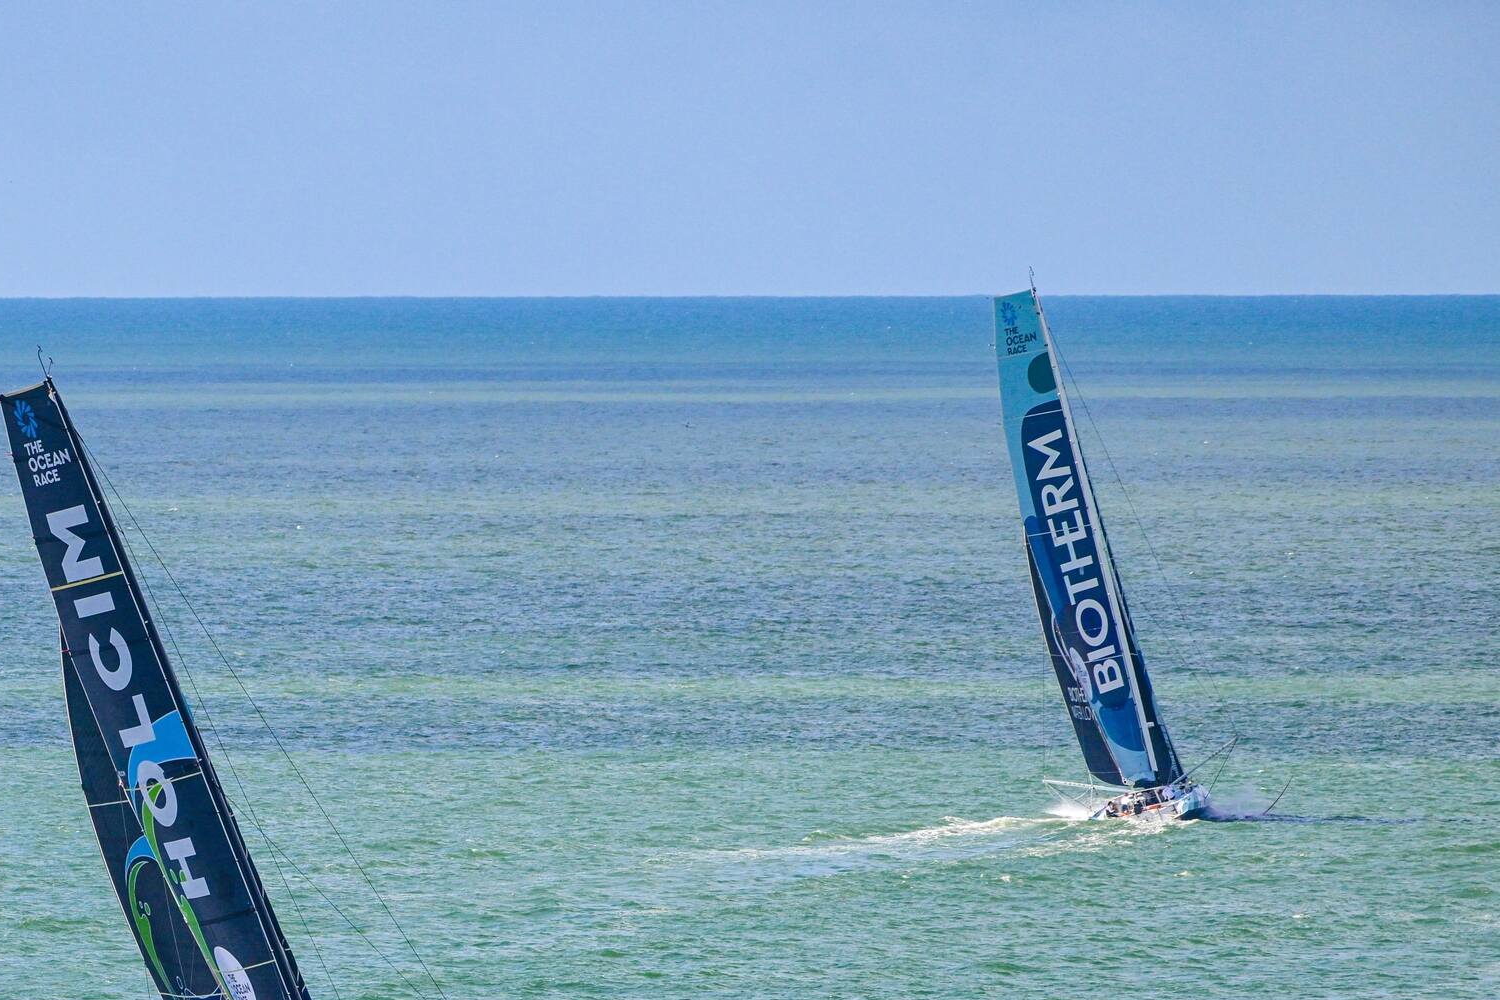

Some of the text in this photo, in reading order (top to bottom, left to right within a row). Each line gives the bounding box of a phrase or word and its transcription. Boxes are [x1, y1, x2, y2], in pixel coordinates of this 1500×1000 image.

[1004, 326, 1019, 336] THE
[1006, 332, 1037, 346] OCEAN
[1007, 344, 1028, 355] RACE
[24, 440, 44, 456] THE
[28, 448, 71, 473] OCEAN
[33, 468, 61, 487] RACE
[1027, 429, 1125, 695] BIOTHERM
[45, 504, 211, 900] HOLCIM
